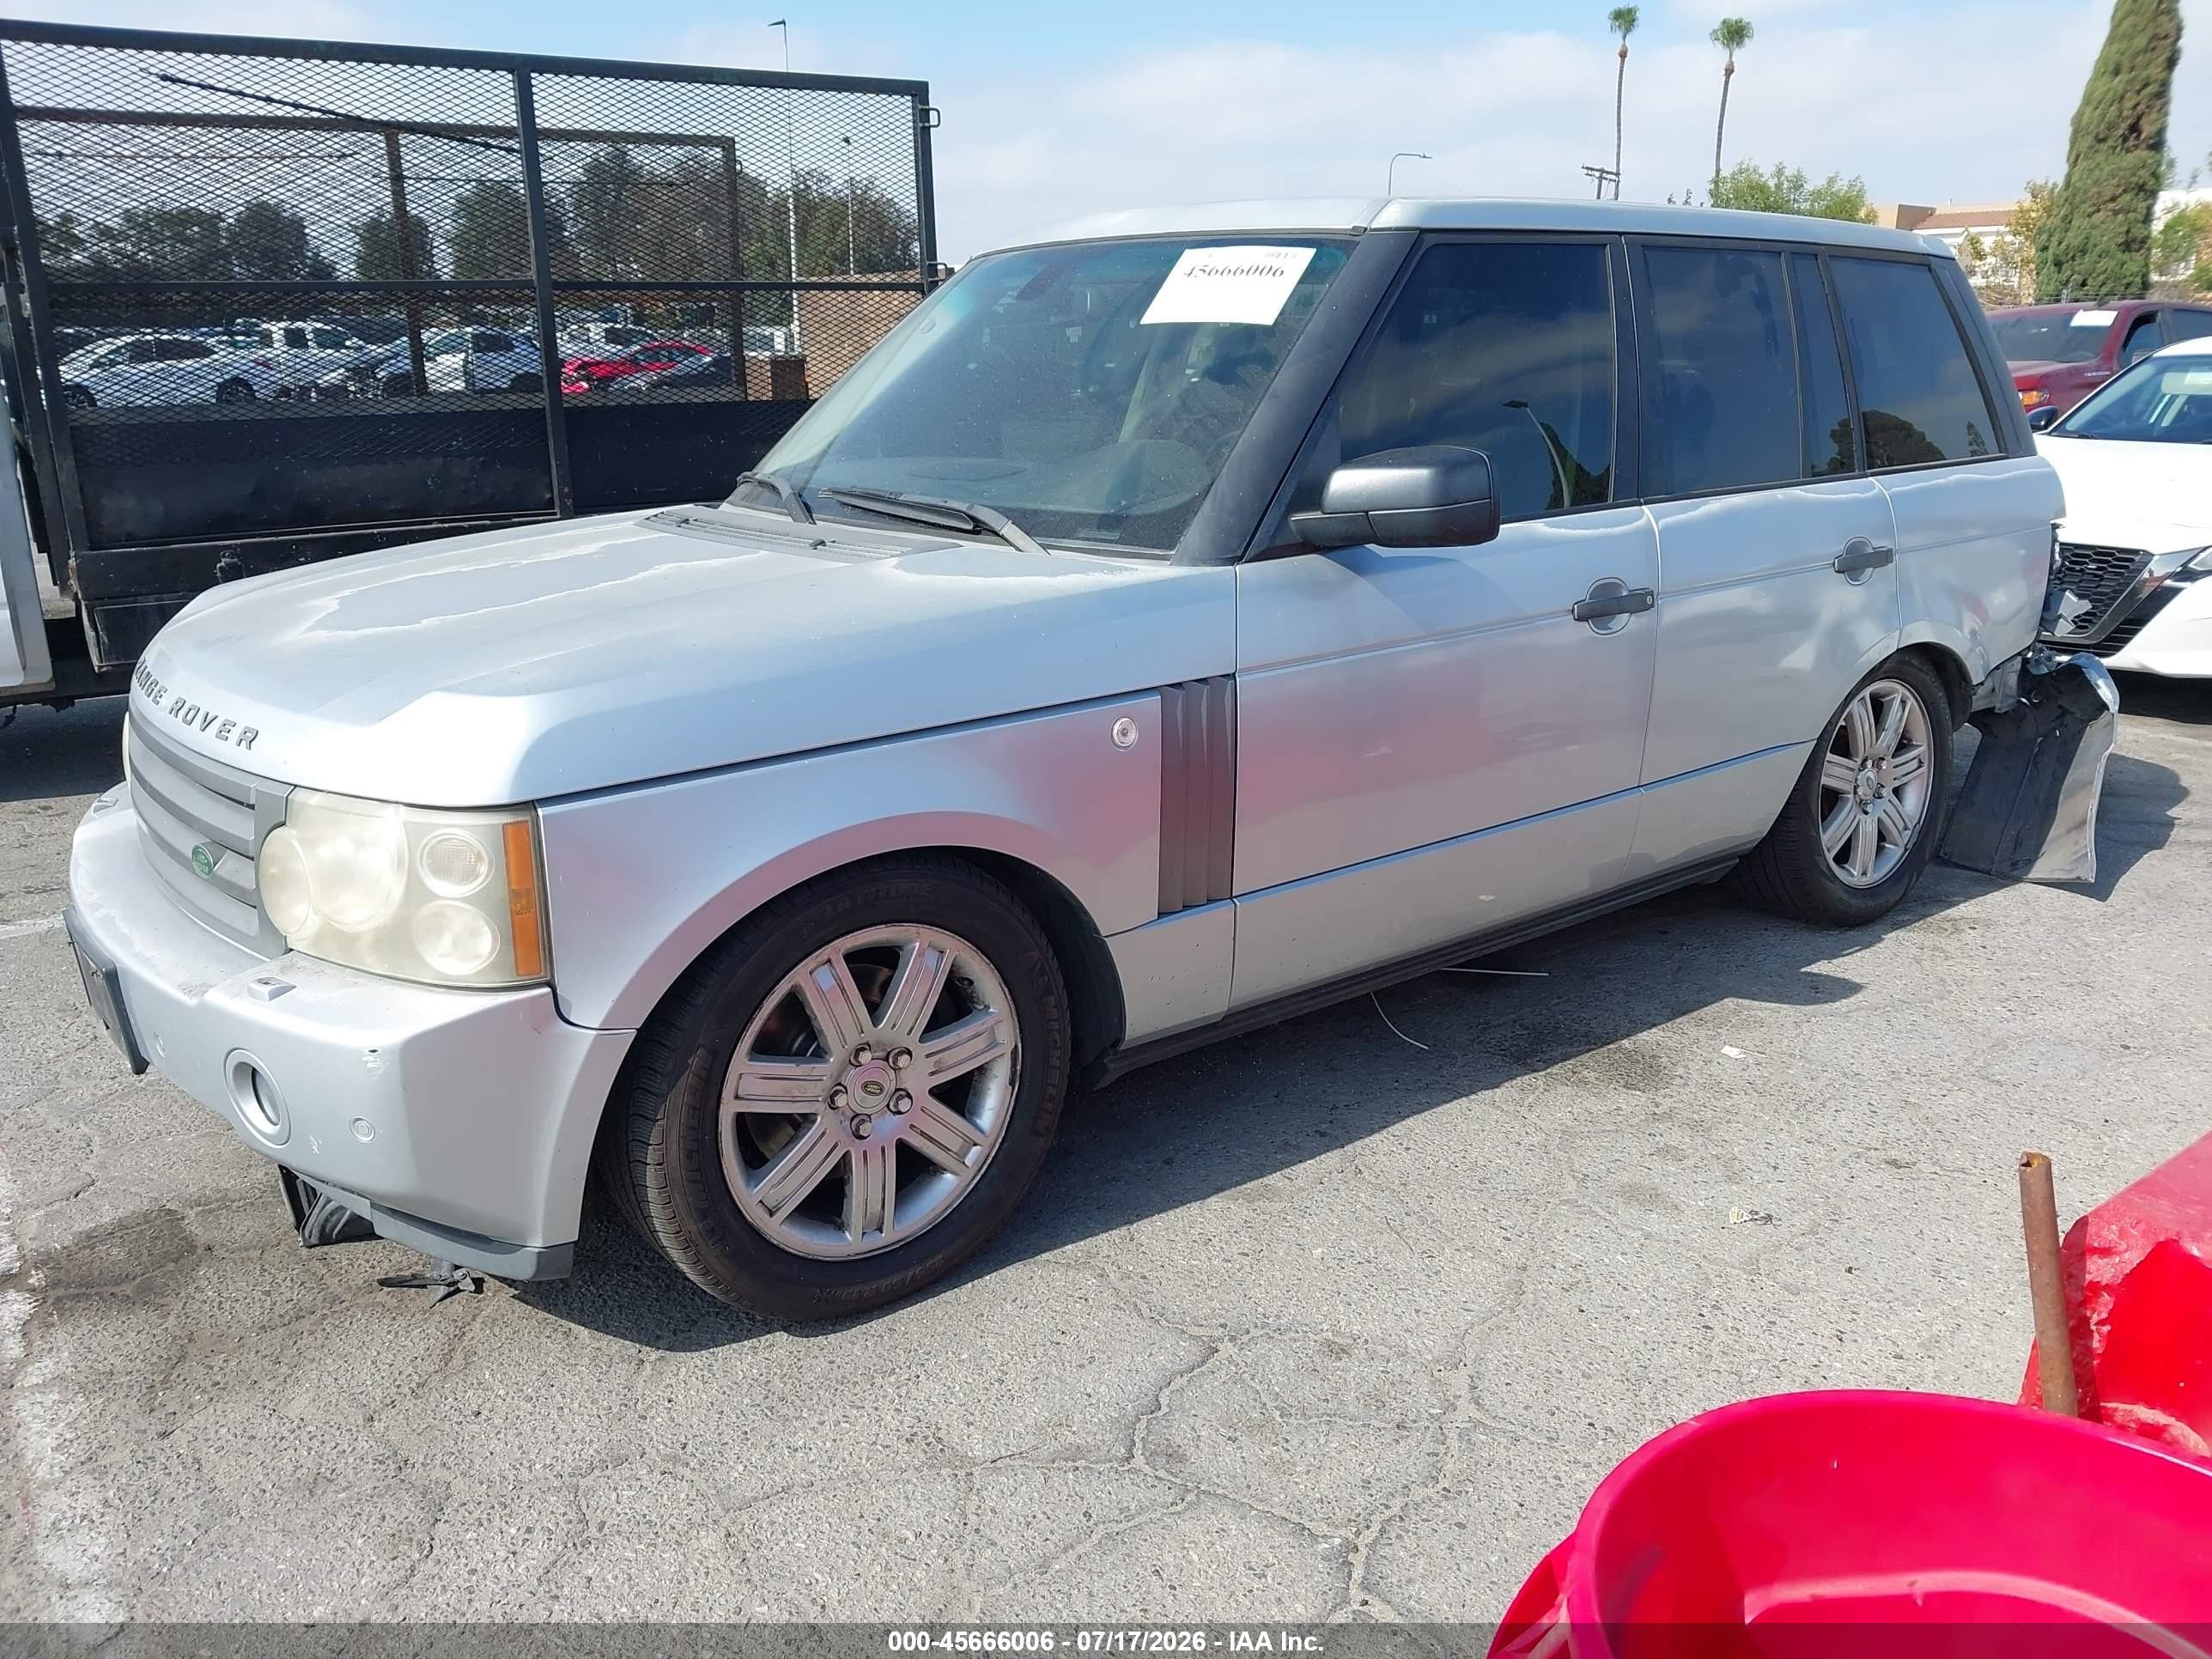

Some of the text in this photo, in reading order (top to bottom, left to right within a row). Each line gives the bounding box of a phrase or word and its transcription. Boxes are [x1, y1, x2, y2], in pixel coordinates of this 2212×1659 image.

[1183, 264, 1285, 278] 45666006
[168, 696, 258, 750] ROVER
[1034, 994, 1062, 1130] MICHELIN
